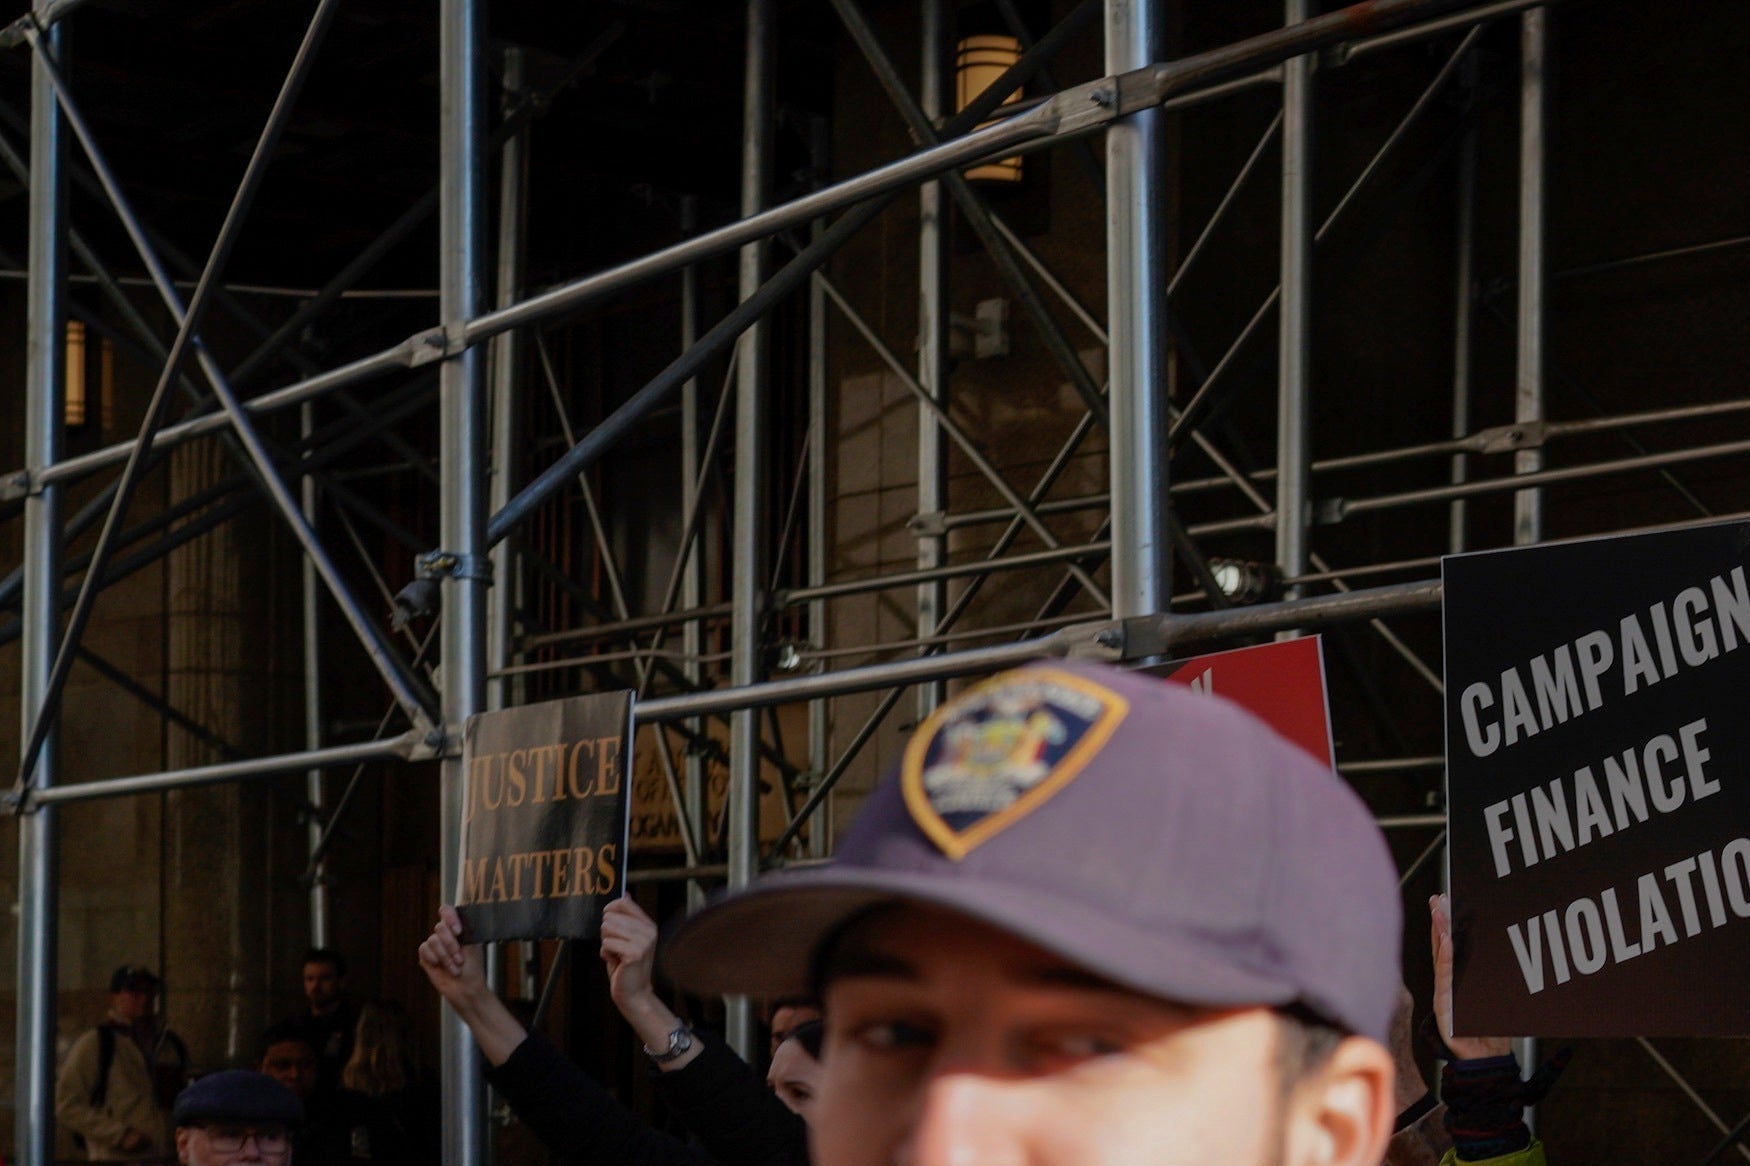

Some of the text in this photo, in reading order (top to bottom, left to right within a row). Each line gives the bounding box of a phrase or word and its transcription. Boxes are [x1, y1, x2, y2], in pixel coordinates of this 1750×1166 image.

[464, 735, 623, 822] JUSTICE
[1484, 718, 1721, 878] FINANCE
[462, 842, 617, 905] MATTERS
